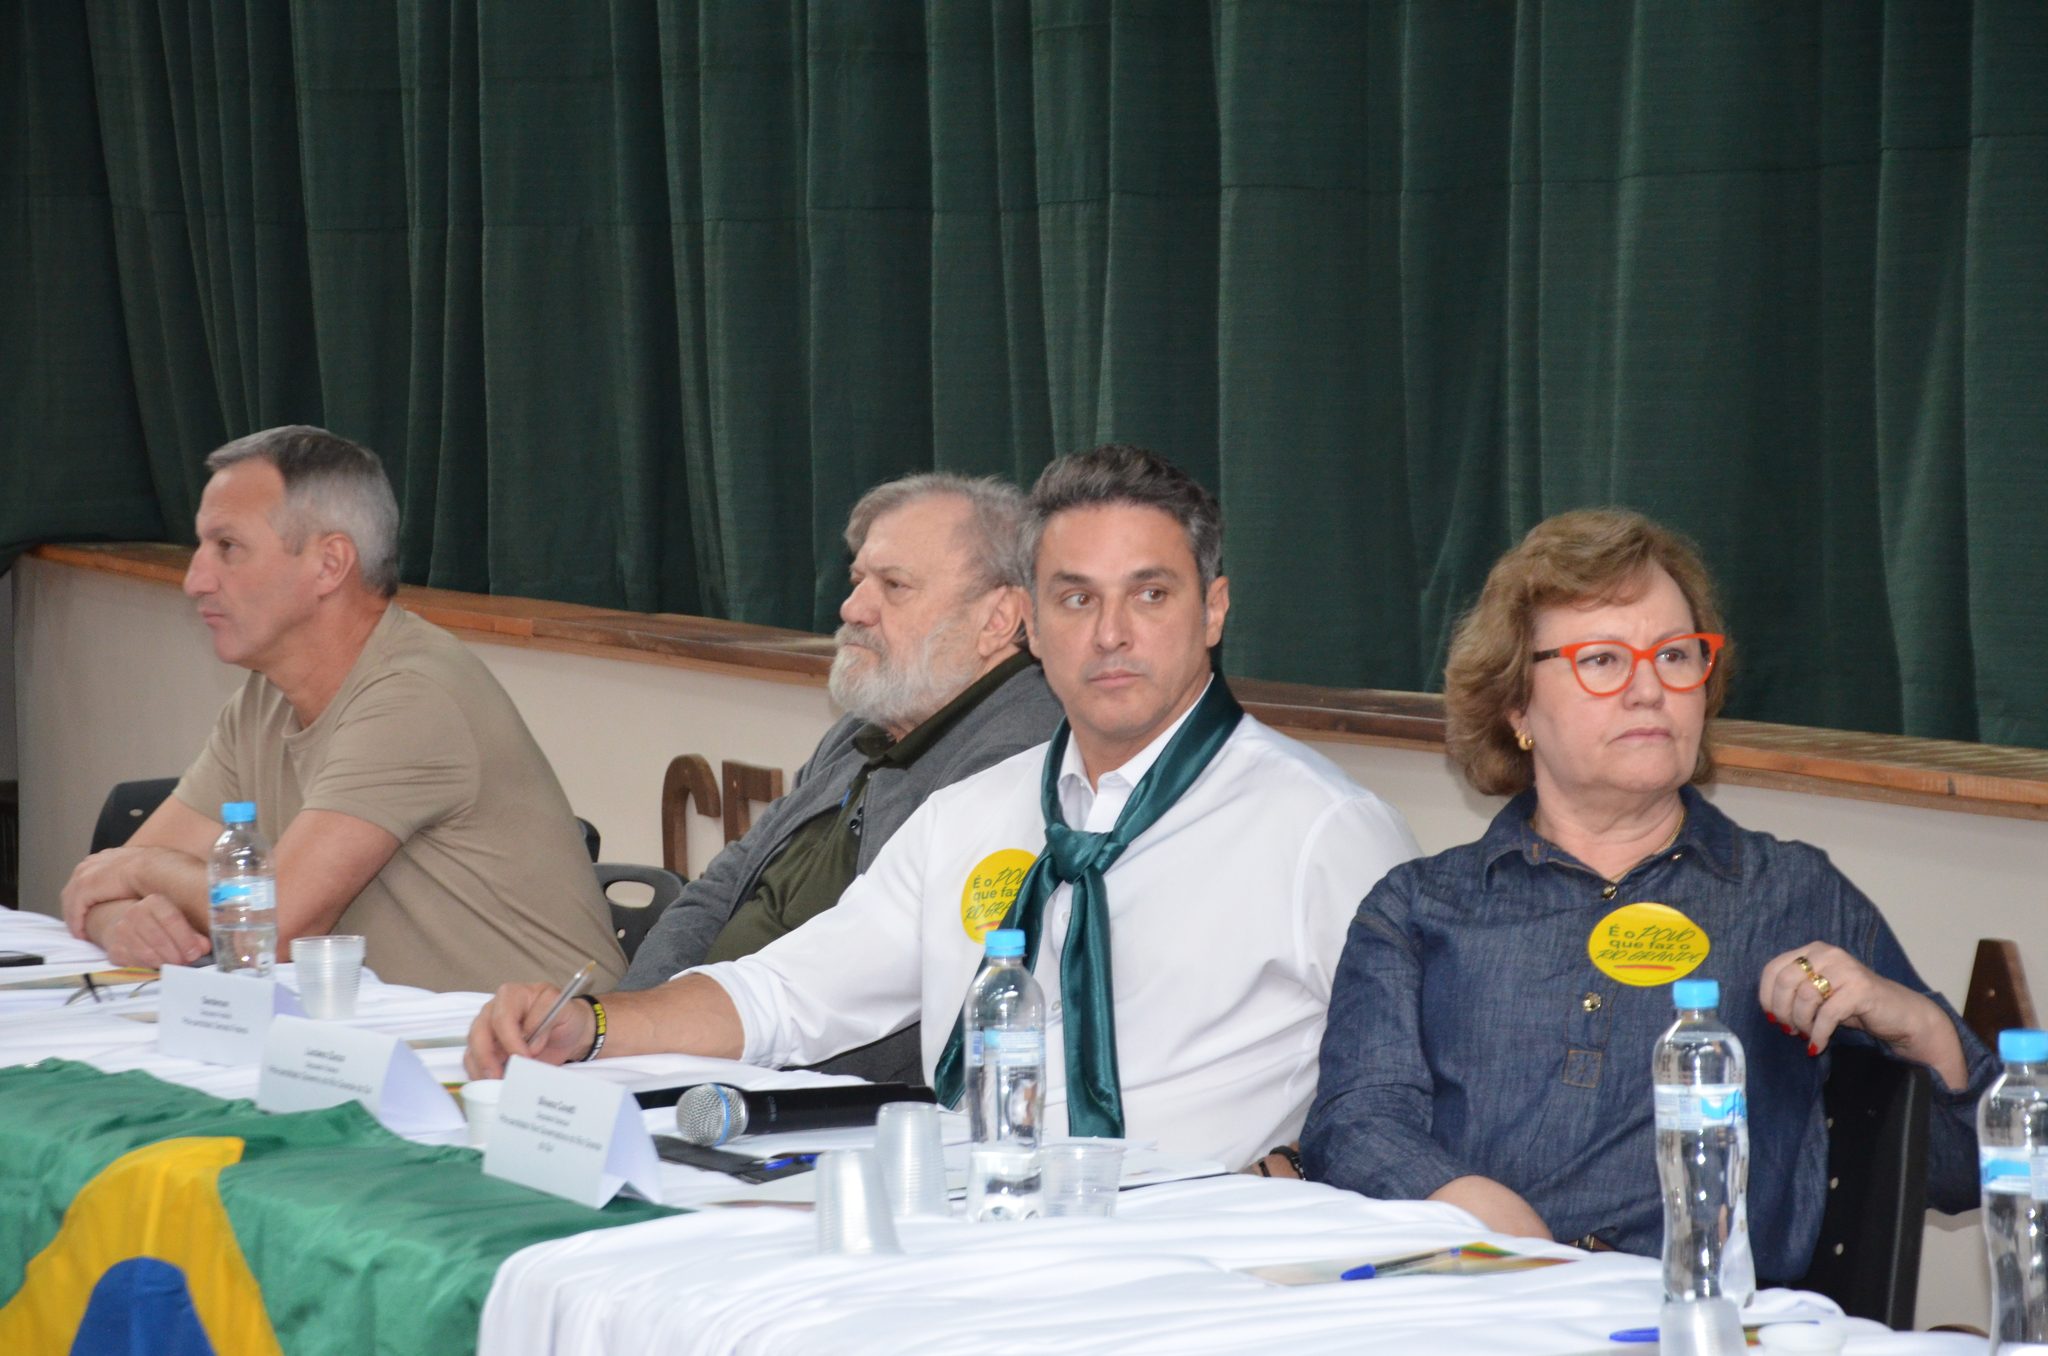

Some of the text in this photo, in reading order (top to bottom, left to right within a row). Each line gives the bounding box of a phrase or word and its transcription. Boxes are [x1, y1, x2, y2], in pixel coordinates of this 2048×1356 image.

[973, 875, 982, 889] É
[984, 878, 992, 886] o
[973, 888, 997, 902] que
[1608, 924, 1697, 943] É o POVO
[1609, 940, 1690, 951] que faz o
[1628, 950, 1704, 963] GRANDE
